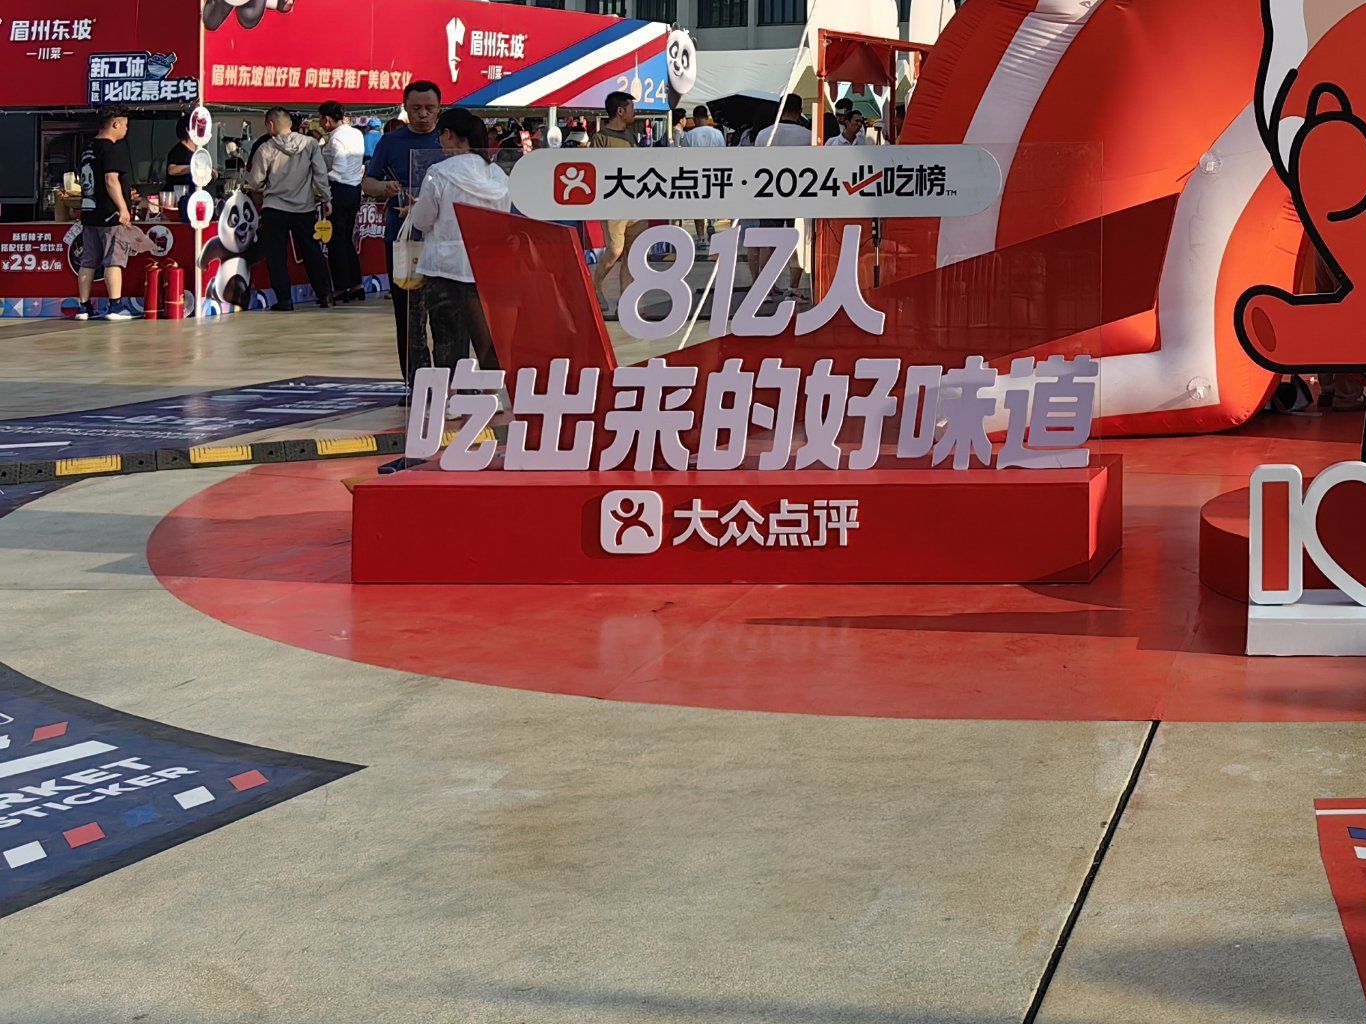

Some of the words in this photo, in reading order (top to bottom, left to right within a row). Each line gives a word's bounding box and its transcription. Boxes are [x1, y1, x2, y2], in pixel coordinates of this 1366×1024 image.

[10, 18, 93, 42] 眉州东坡
[37, 47, 63, 60] 川菜
[470, 30, 526, 60] 眉州东坡
[90, 57, 146, 78] 新工体
[211, 64, 302, 88] 眉州东坡做好饭
[304, 67, 413, 91] 向世界推广美食文化
[104, 79, 198, 102] 必吃嘉年华
[617, 225, 886, 340] 8亿人
[405, 355, 1101, 472] 吃出来的好味道
[672, 499, 861, 547] 大众点评
